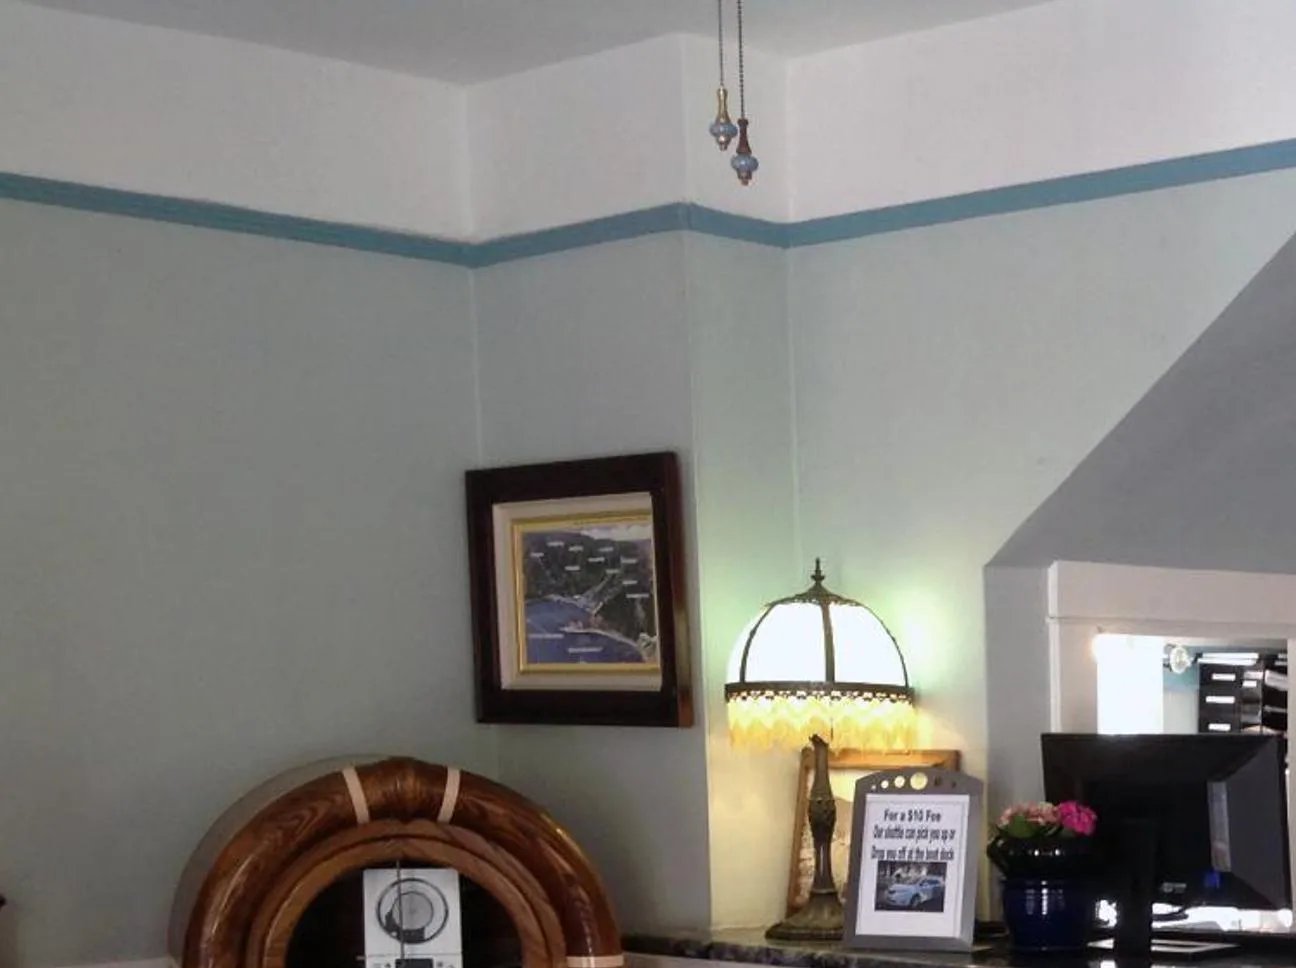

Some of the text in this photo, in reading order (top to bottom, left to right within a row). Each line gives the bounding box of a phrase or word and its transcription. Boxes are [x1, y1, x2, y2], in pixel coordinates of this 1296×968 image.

[884, 809, 898, 821] For
[900, 812, 906, 821] a
[926, 809, 941, 822] Fee
